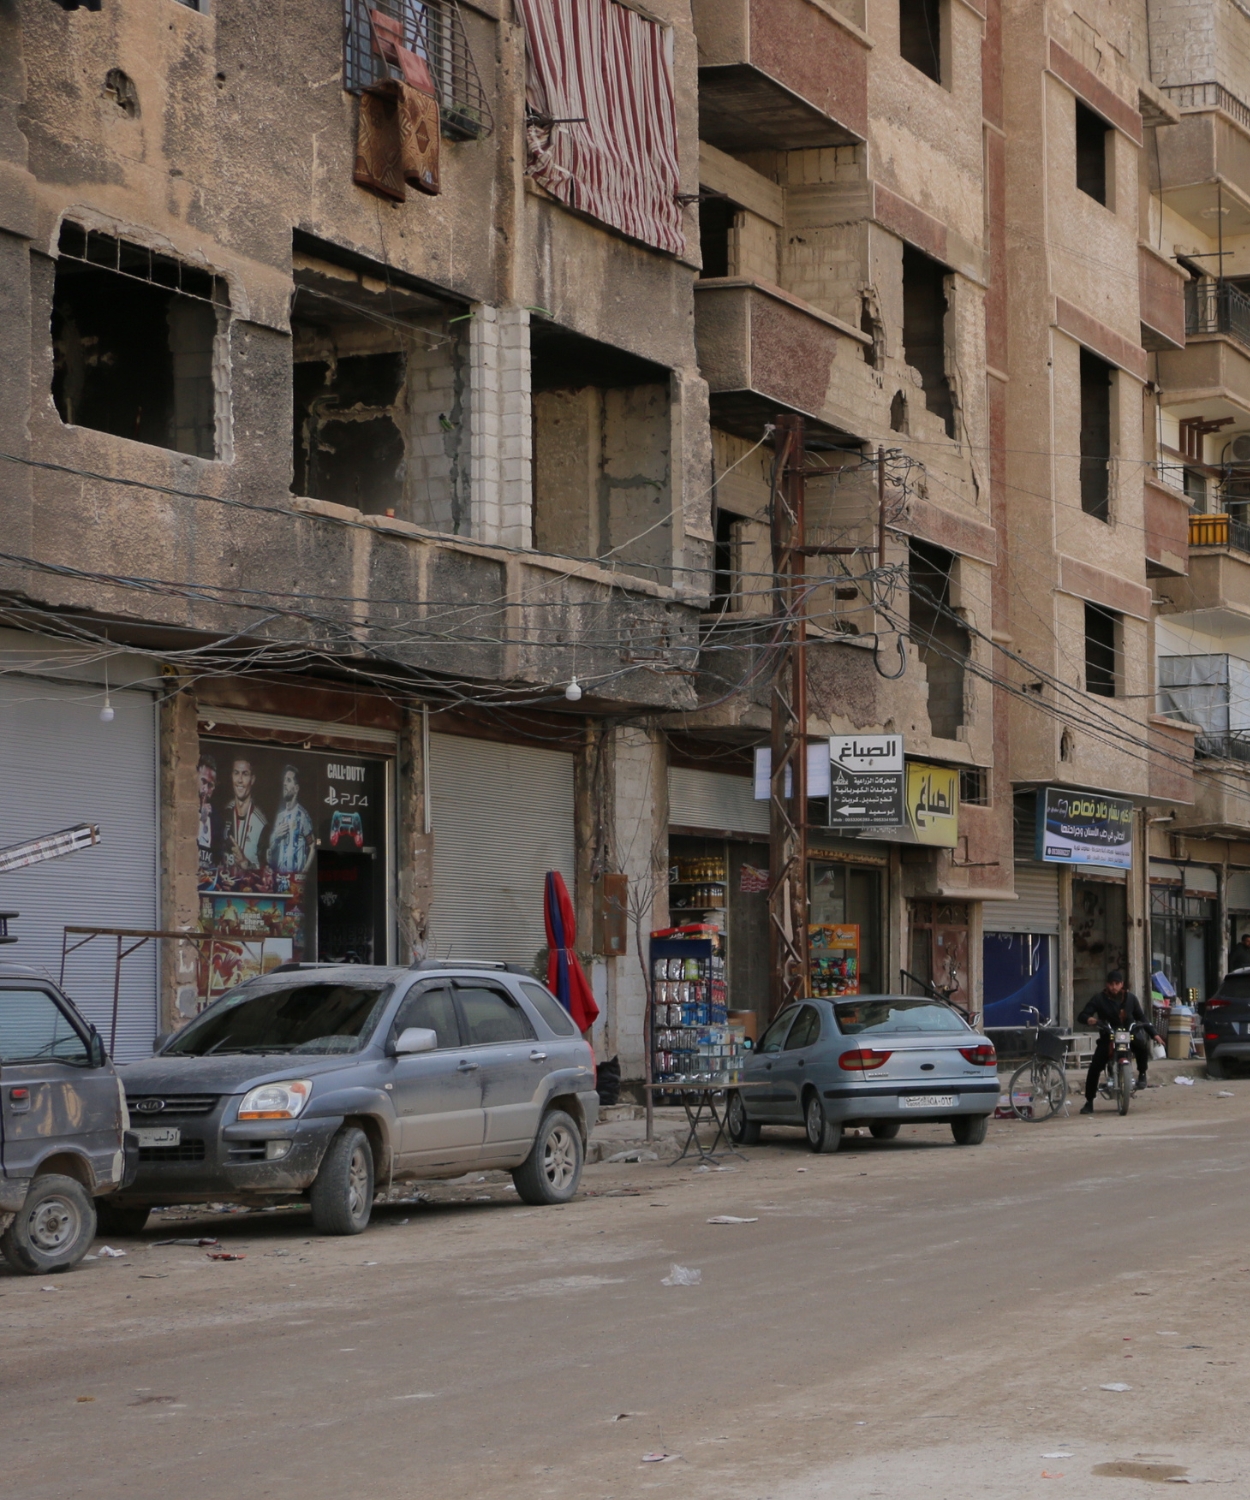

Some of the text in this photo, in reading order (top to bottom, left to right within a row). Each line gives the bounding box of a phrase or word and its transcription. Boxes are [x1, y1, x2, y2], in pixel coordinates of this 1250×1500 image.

[839, 740, 896, 763] الصباغ
[327, 763, 366, 782] CALL DUTY
[853, 776, 875, 786] الزراعية
[835, 785, 898, 795] والمولدات الكهربائية
[340, 792, 369, 807] PS4
[880, 795, 893, 804] قطع
[915, 773, 955, 831] الصباغ
[1095, 799, 1107, 819] خالد
[1107, 800, 1120, 823] بشار
[1060, 823, 1083, 837] وجراحتها
[1099, 828, 1108, 840] طب
[1107, 830, 1114, 842] في
[153, 1130, 178, 1144] ادلب
